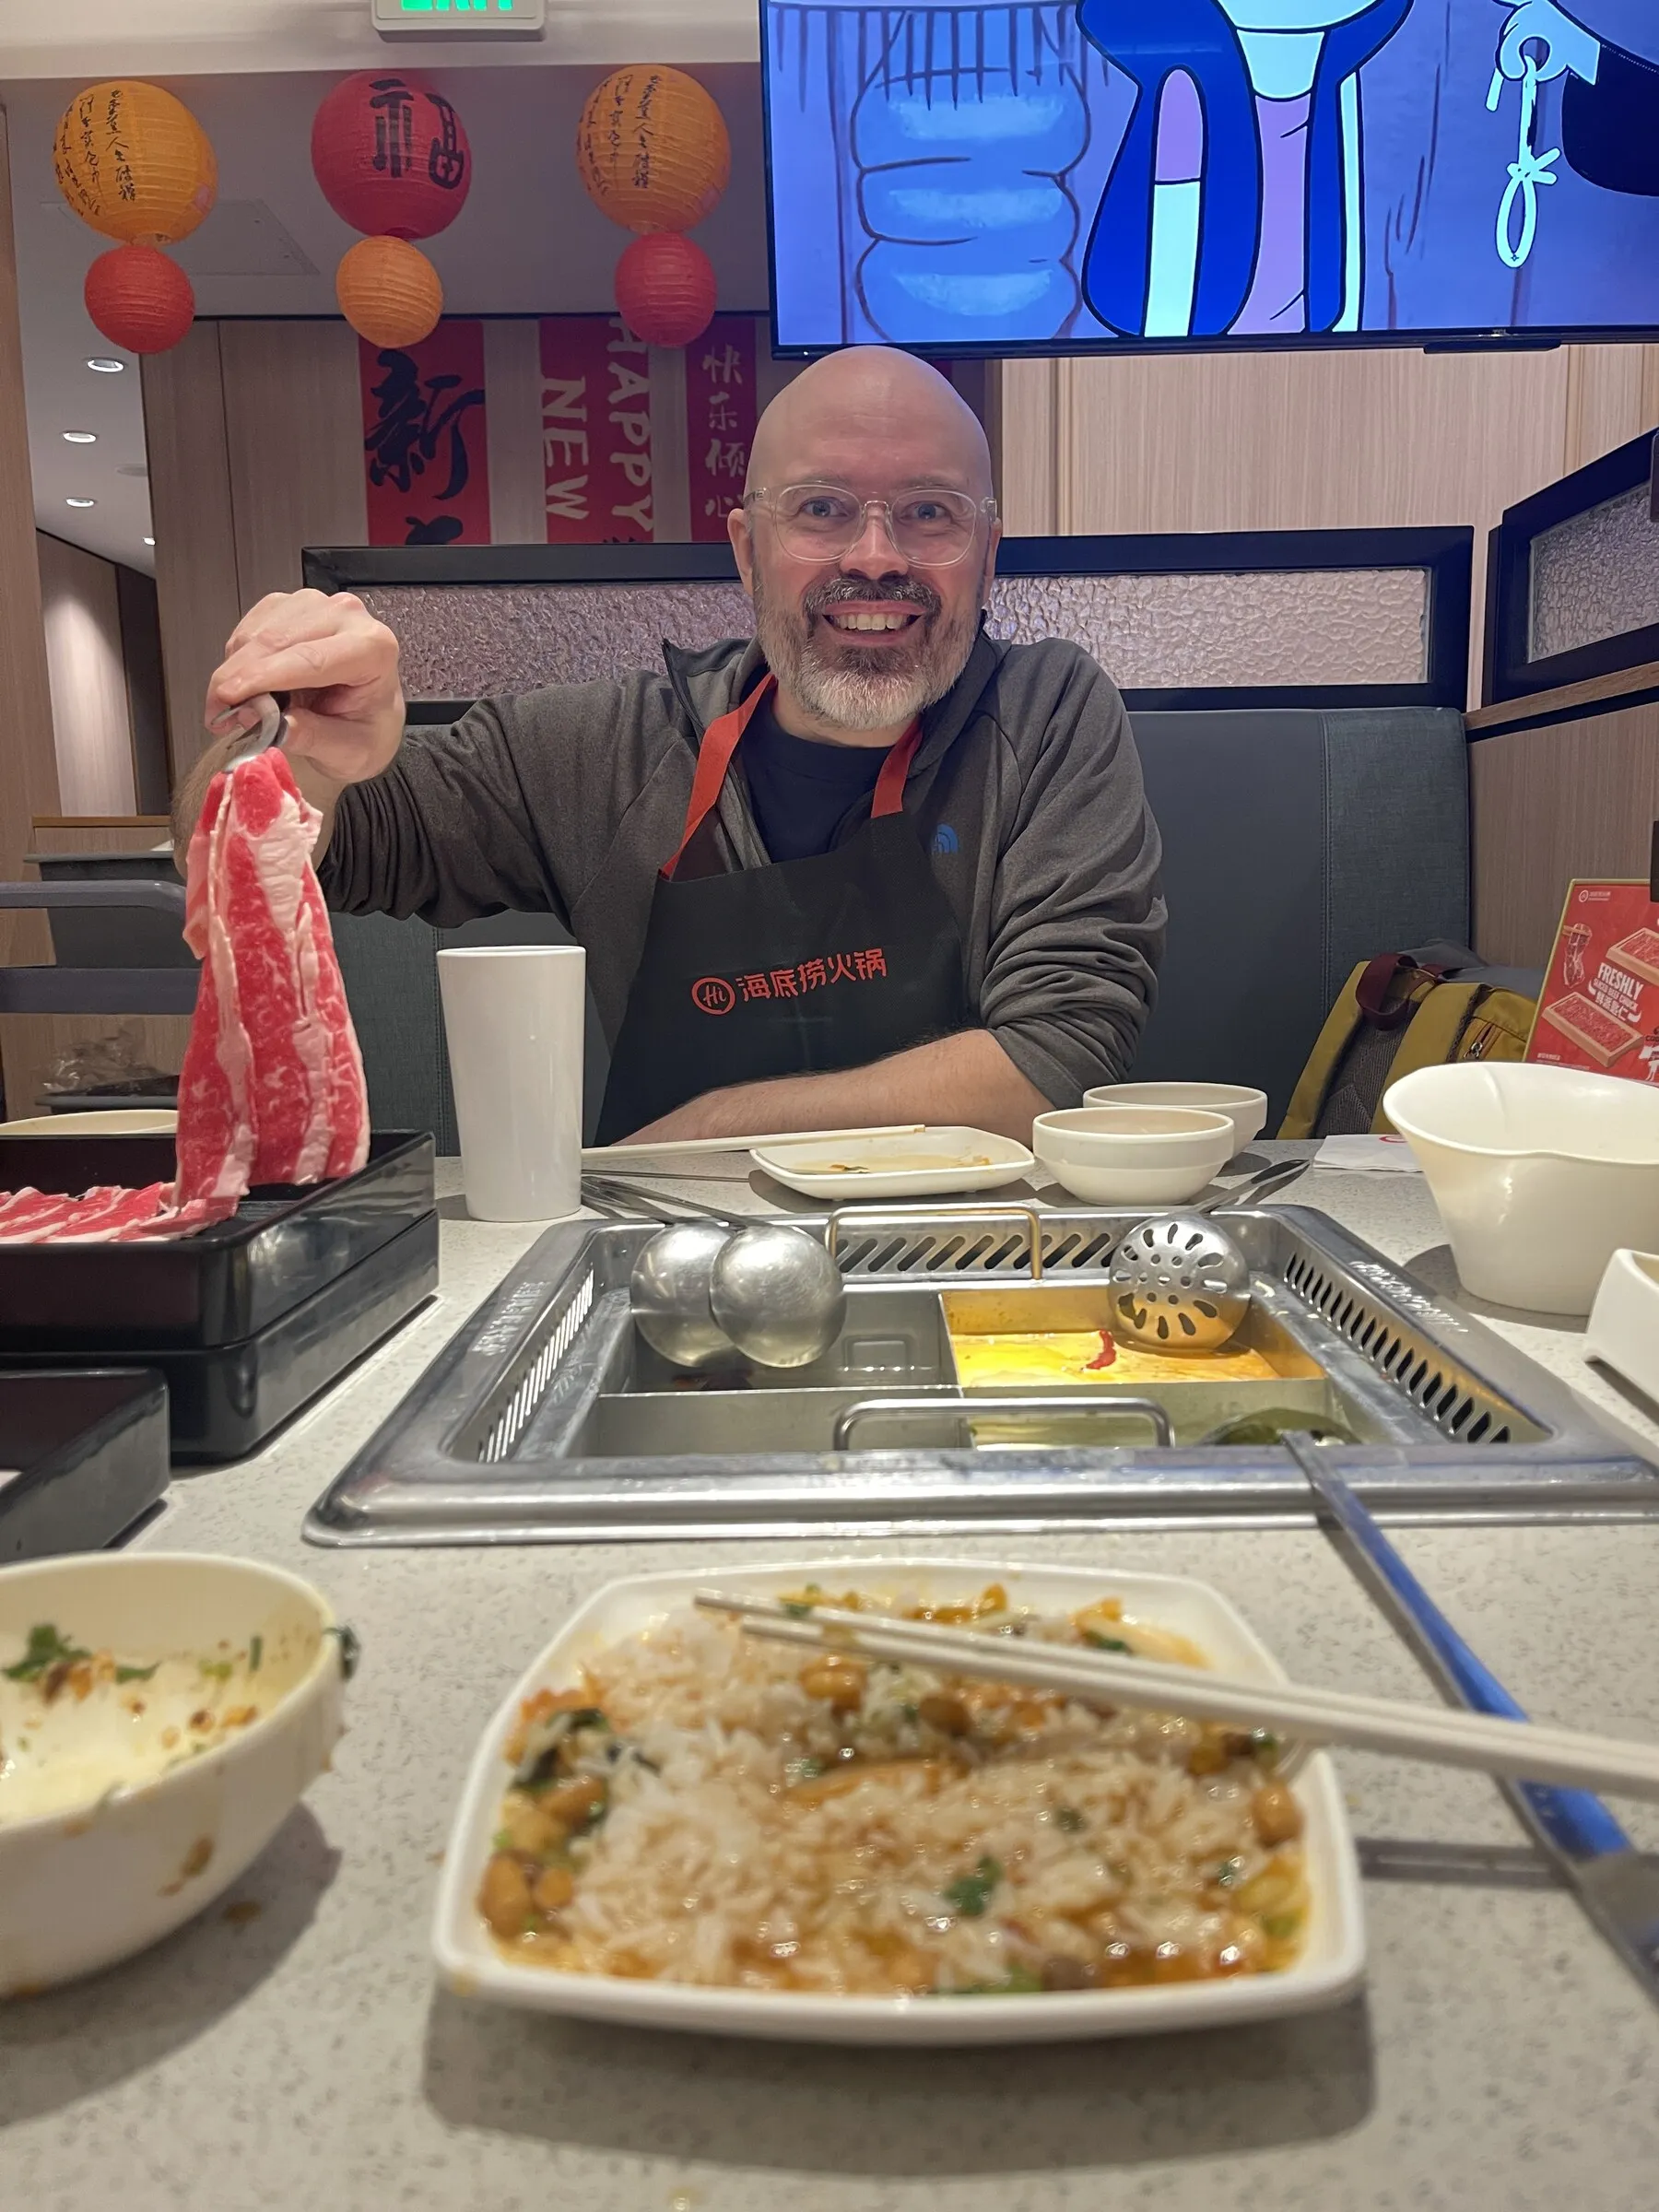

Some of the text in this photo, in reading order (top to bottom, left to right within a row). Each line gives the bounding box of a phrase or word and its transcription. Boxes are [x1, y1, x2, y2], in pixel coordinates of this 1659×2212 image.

[541, 376, 590, 521] NEW
[735, 947, 887, 1003] 海底捞火锅
[1597, 961, 1644, 1001] FRESHLY
